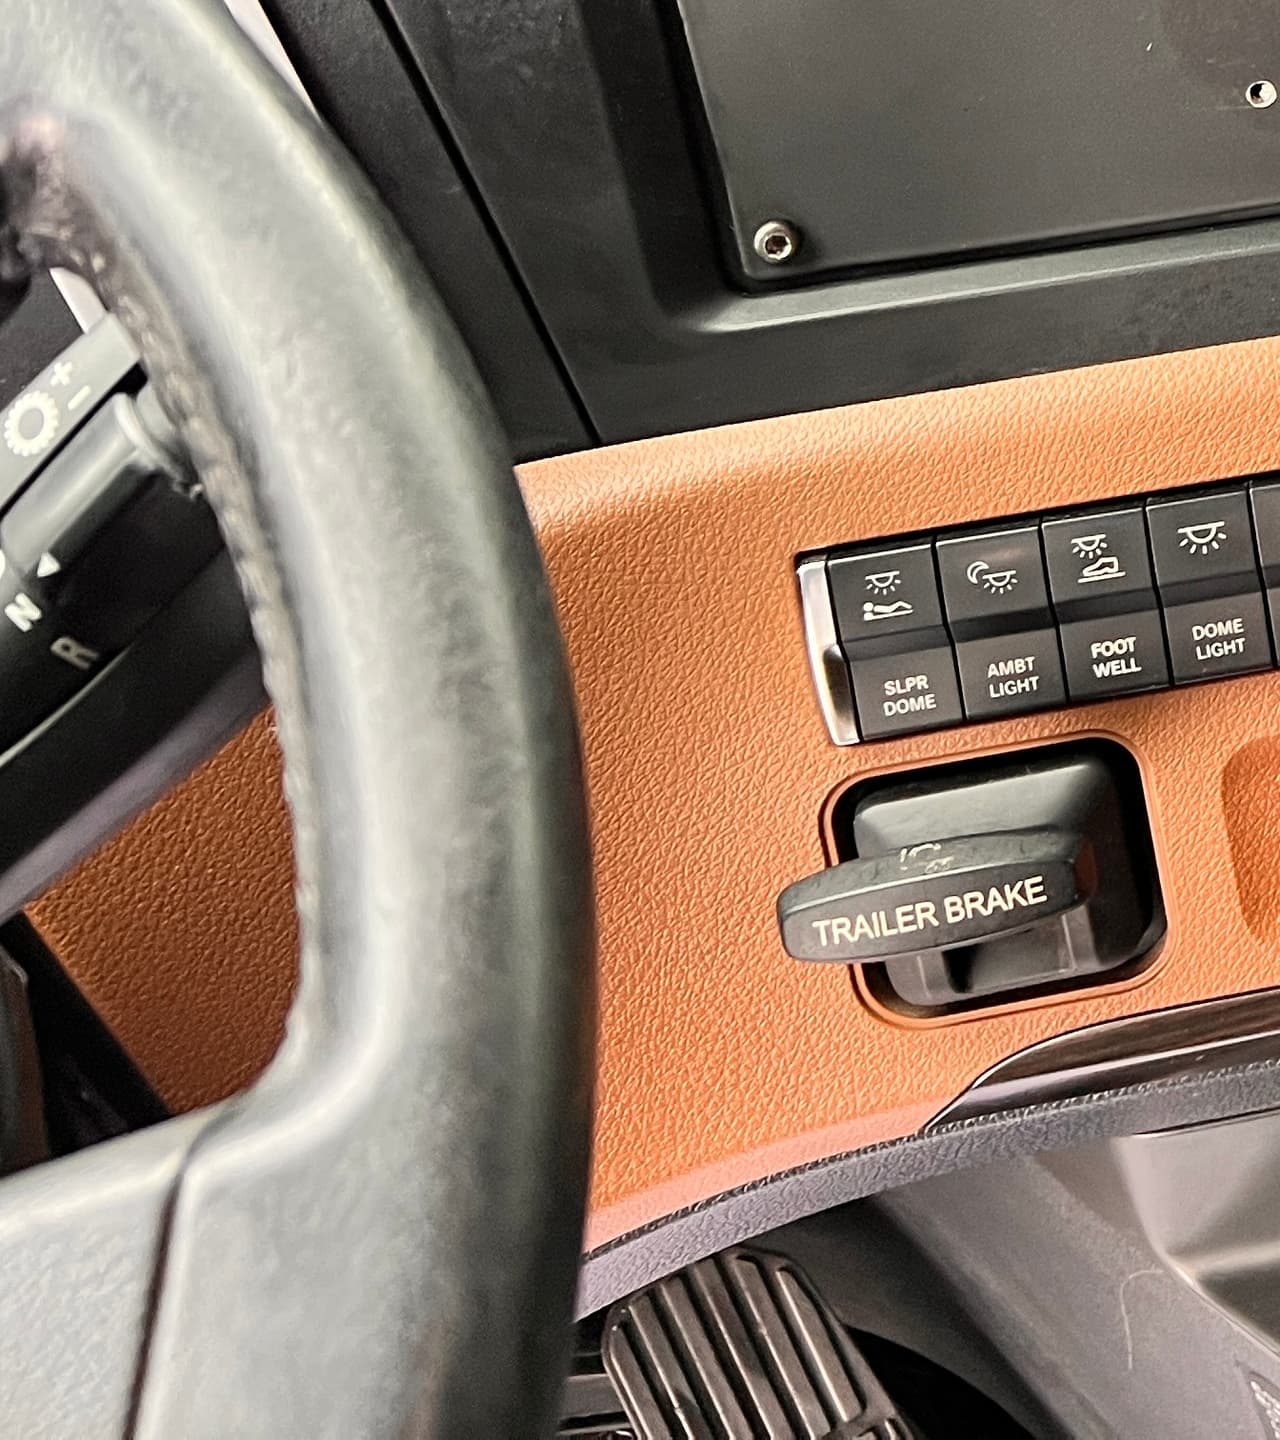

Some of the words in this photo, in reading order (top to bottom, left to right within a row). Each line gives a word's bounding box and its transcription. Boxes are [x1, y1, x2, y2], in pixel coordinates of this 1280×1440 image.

[6, 592, 42, 632] N
[1191, 617, 1244, 642] DOME
[50, 635, 100, 671] R
[1090, 635, 1137, 659] FOOT
[1195, 636, 1245, 660] LIGHT
[987, 656, 1036, 679] AMBT
[1092, 654, 1142, 679] WELL
[884, 673, 929, 696] SLPR
[989, 675, 1040, 699] LIGHT
[883, 692, 936, 716] DOME
[812, 901, 939, 947] TRAILER
[944, 875, 1048, 924] BRAKE
